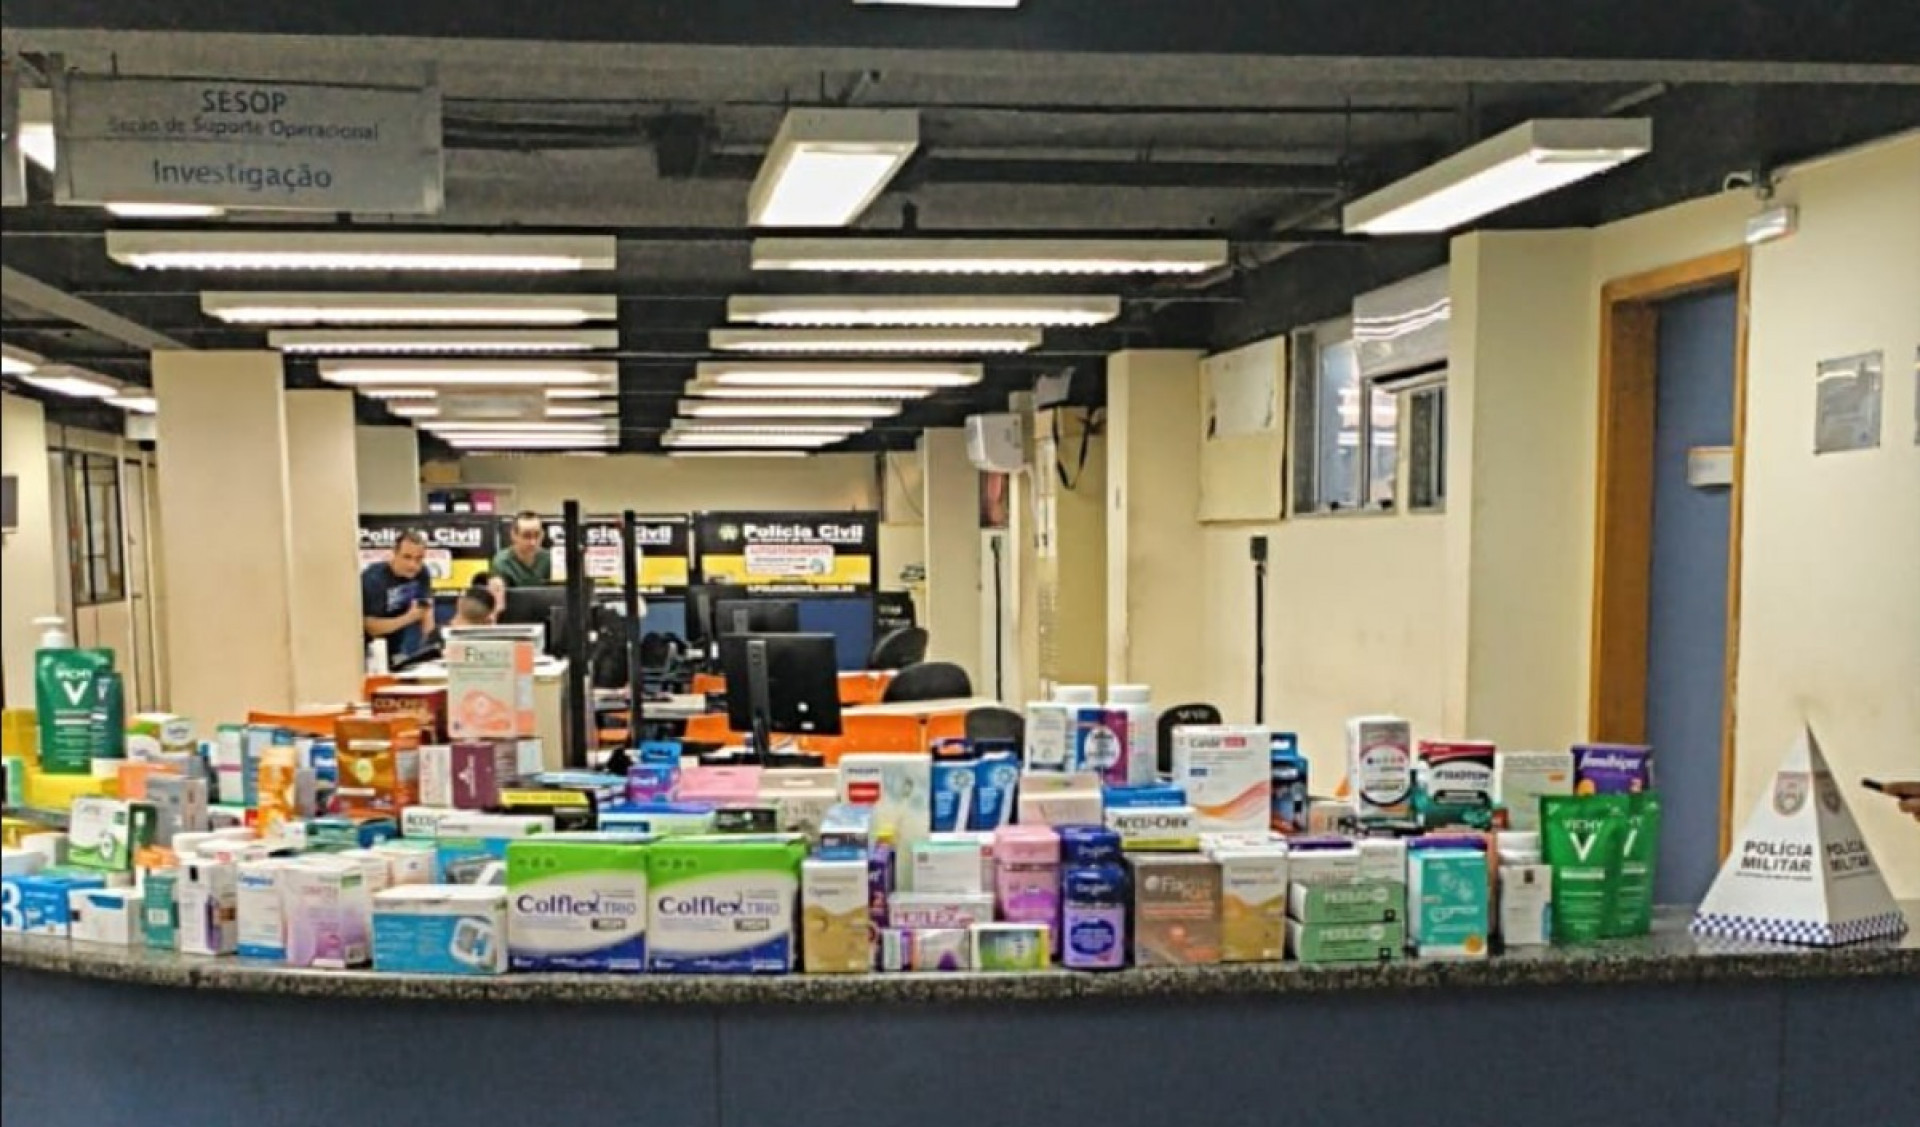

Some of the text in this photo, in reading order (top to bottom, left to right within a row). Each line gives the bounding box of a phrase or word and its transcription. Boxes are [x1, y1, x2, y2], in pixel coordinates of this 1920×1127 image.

[202, 89, 287, 114] SESOP
[269, 119, 378, 141] Operacional
[153, 158, 332, 192] Investigação
[818, 524, 863, 539] Civil
[1744, 838, 1813, 857] POLÍCIA
[1741, 857, 1811, 872] MILITAR
[516, 888, 601, 915] Colflex
[658, 888, 744, 916] Colflex
